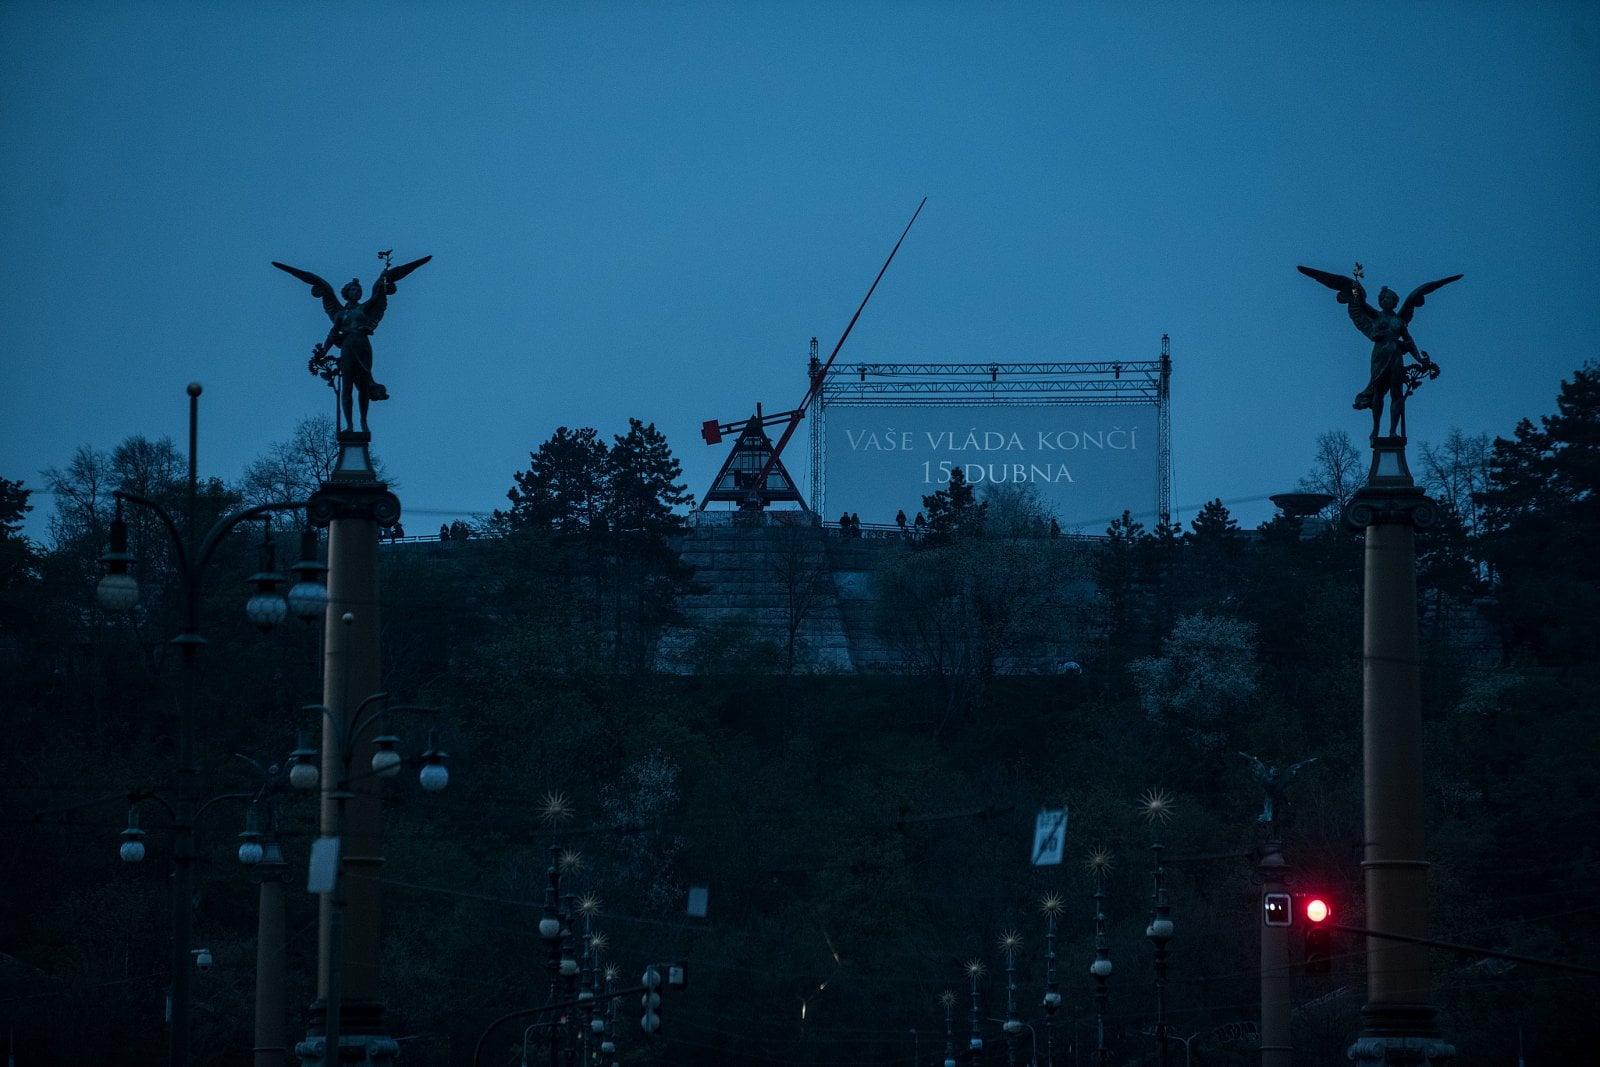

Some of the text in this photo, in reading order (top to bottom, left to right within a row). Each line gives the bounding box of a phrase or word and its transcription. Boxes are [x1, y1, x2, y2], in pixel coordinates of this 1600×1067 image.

[845, 426, 1138, 451] VAŠE VLÁDA KONČÍ
[964, 463, 1074, 484] DUBNA
